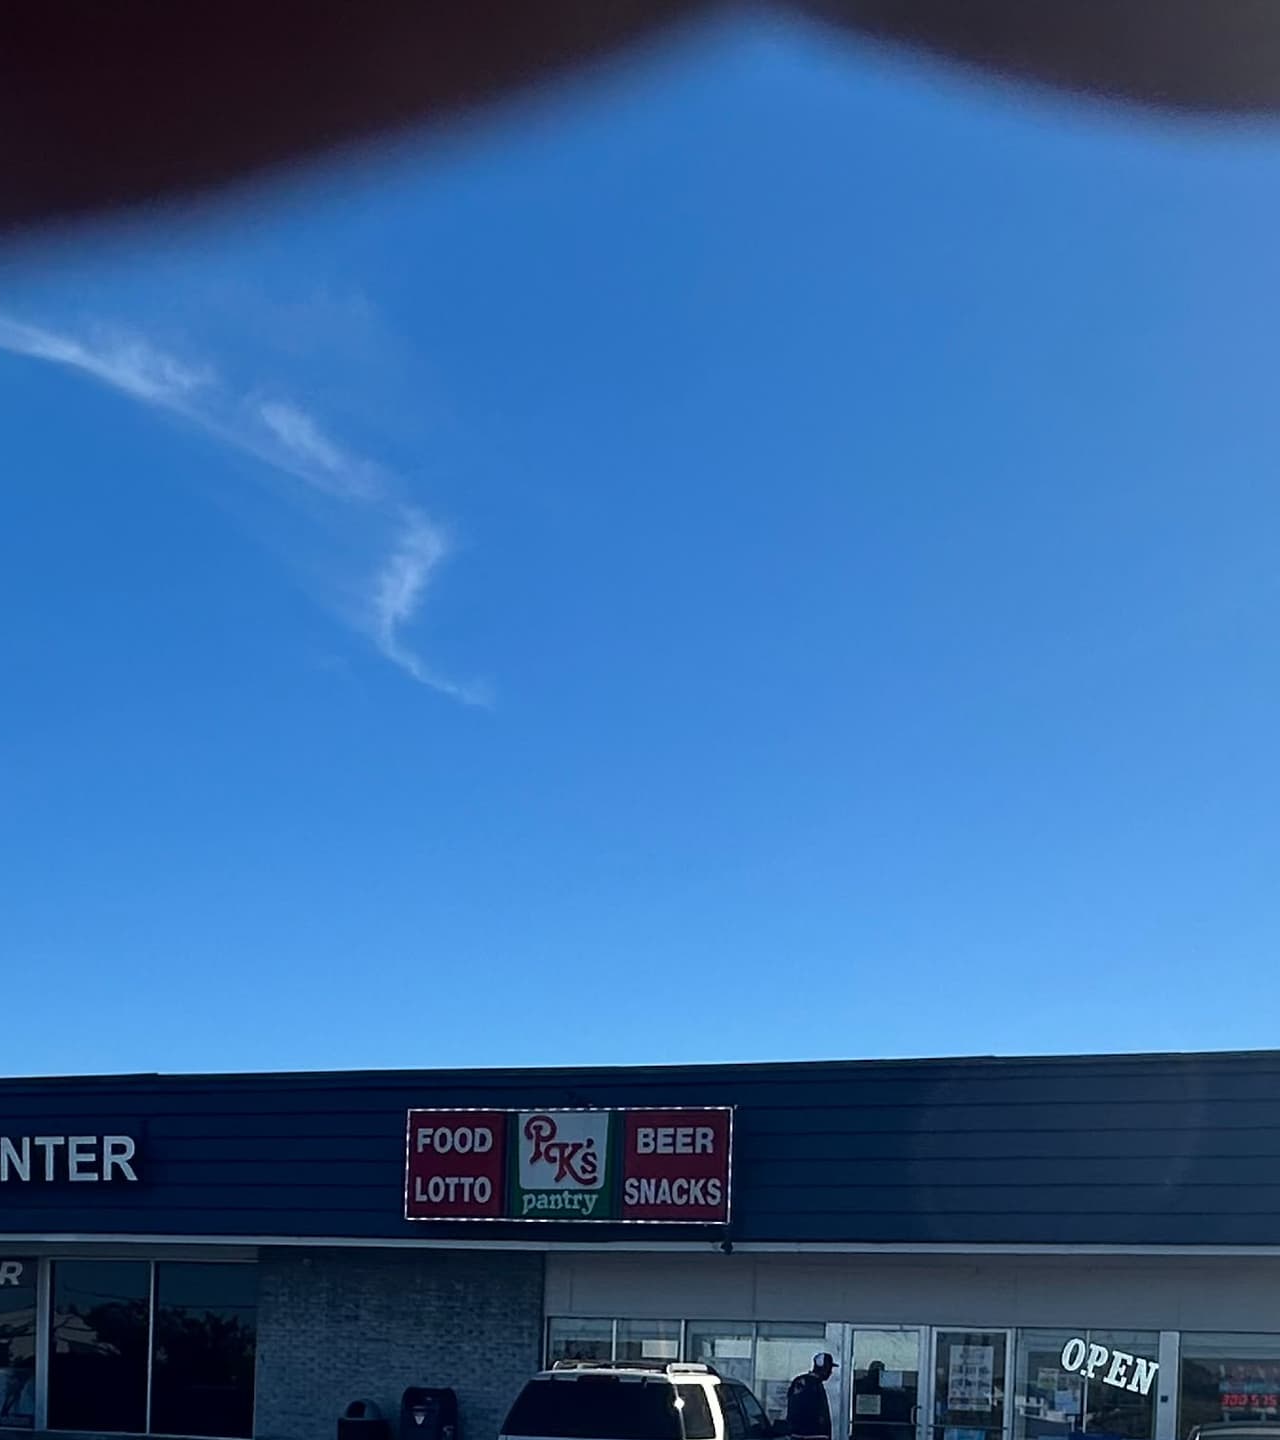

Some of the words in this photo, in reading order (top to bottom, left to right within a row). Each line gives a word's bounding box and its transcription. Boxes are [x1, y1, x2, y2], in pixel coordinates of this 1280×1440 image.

[417, 1127, 493, 1153] FOOD
[637, 1127, 714, 1154] BEER
[415, 1177, 492, 1203] LOTTO
[522, 1190, 599, 1215] pantry
[624, 1178, 721, 1206] SNACKS
[1061, 1338, 1160, 1396] OPEN
